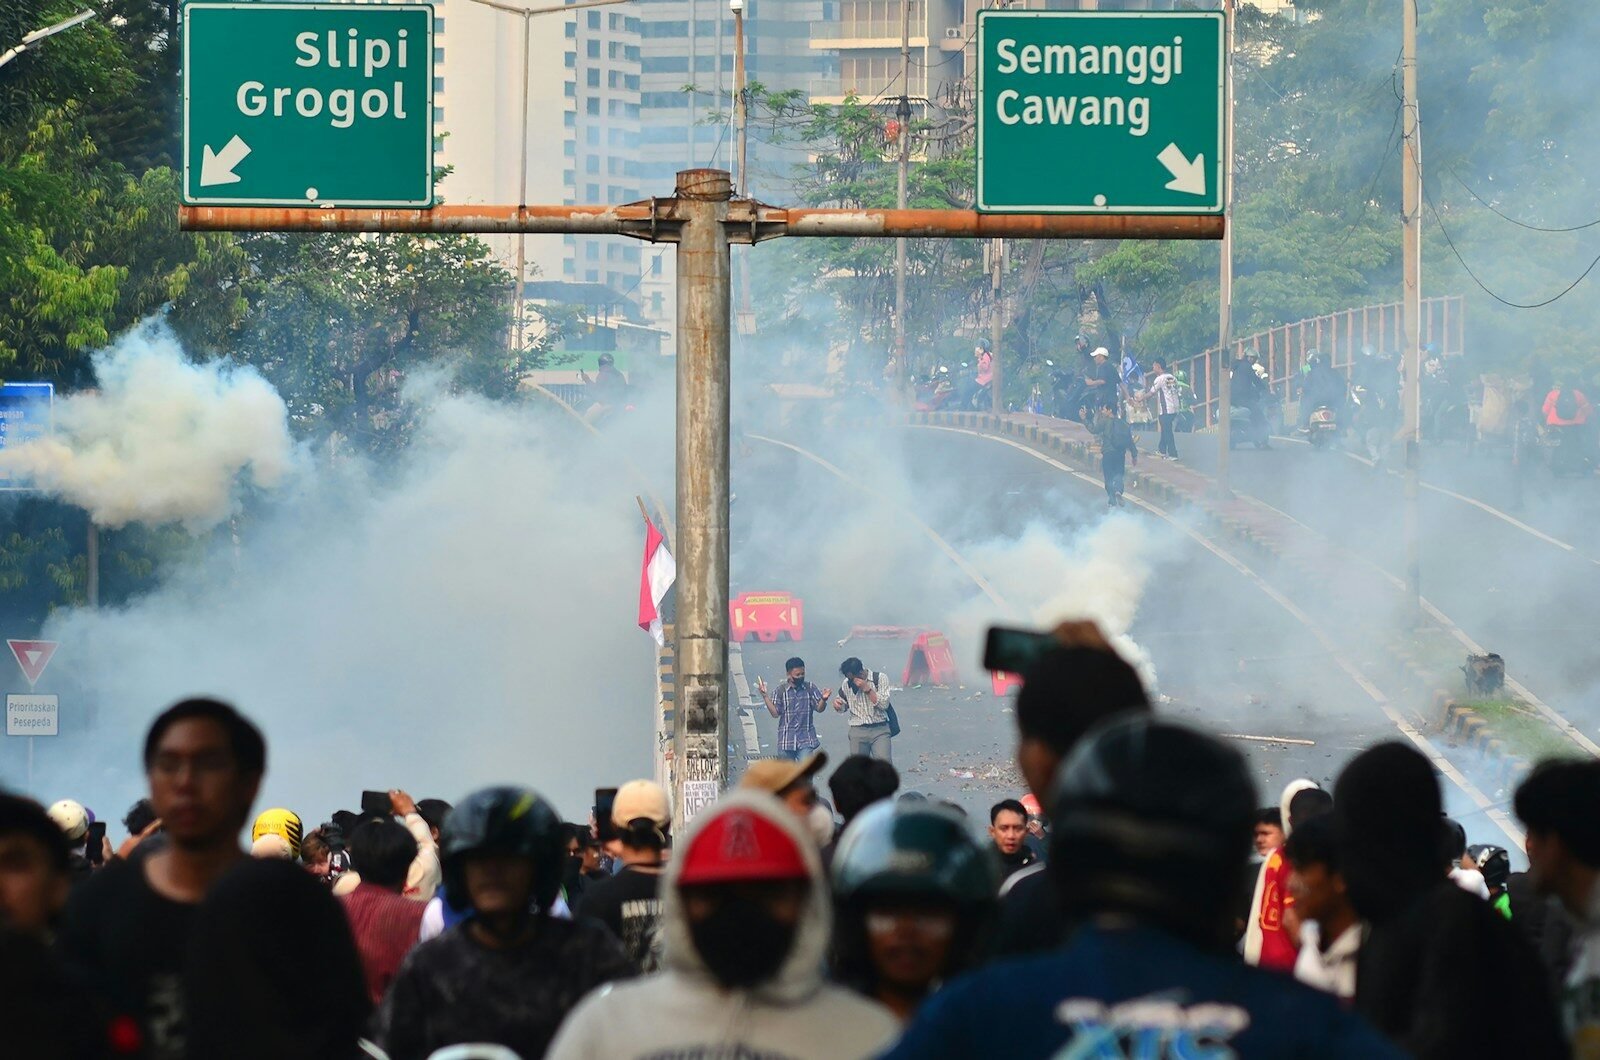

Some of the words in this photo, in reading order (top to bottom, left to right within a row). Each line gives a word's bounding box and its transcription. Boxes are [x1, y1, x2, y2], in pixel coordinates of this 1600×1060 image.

[295, 28, 408, 77] Slipi
[997, 36, 1182, 84] Semanggi
[237, 81, 406, 128] Grogol
[996, 89, 1150, 136] Cawang
[9, 702, 56, 712] Prioritaskan
[14, 717, 51, 728] Pesepeda
